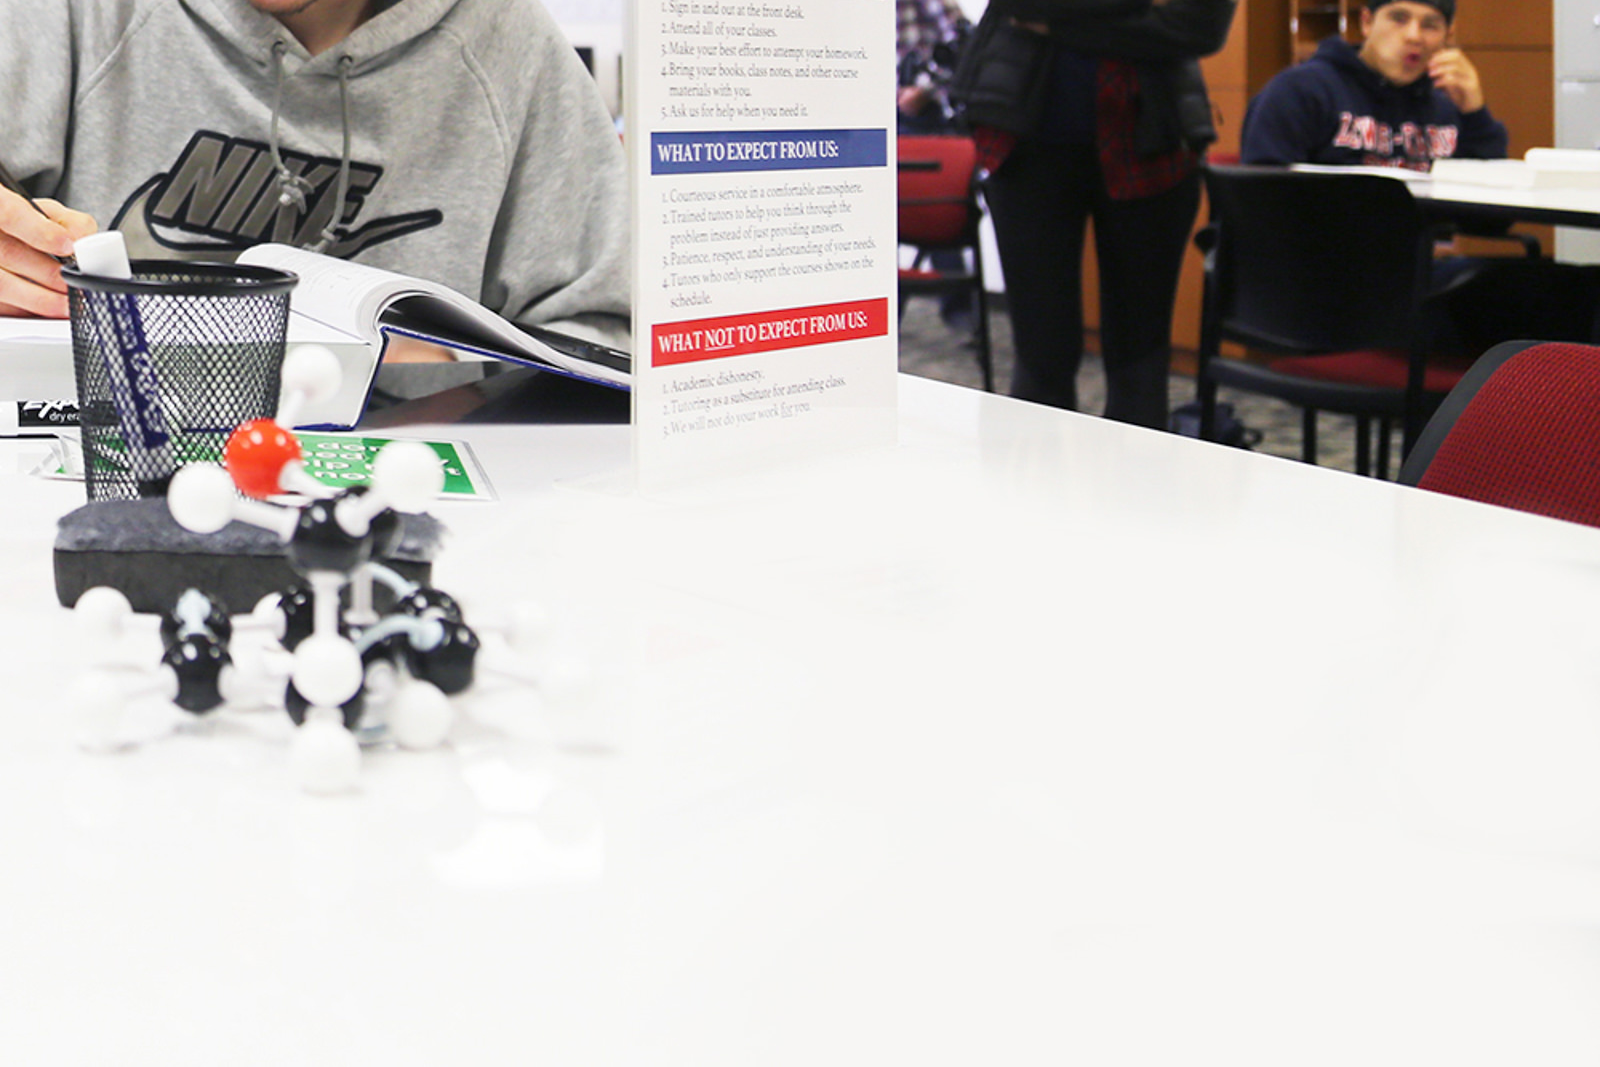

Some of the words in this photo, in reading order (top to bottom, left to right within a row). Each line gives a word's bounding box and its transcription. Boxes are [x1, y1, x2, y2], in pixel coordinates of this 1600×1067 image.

[691, 0, 700, 14] in
[702, 0, 719, 15] and
[721, 5, 735, 16] out
[746, 2, 761, 17] the
[762, 3, 783, 17] front
[670, 20, 700, 35] Attend
[702, 20, 713, 35] all
[715, 21, 725, 35] of
[726, 26, 745, 40] your
[669, 41, 695, 55] Make
[696, 45, 717, 60] your
[719, 42, 737, 56] best
[738, 42, 761, 56] effort
[763, 46, 771, 57] to
[805, 48, 823, 62] your
[670, 61, 694, 80] Bring
[696, 66, 717, 80] your
[747, 62, 767, 77] class
[795, 64, 810, 78] and
[811, 64, 832, 78] other
[833, 68, 859, 79] course
[669, 82, 711, 96] materials
[712, 82, 733, 96] with
[671, 102, 687, 117] Ask
[688, 107, 699, 118] us
[701, 102, 714, 117] for
[715, 102, 735, 122] help
[736, 103, 760, 117] when
[761, 107, 778, 121] you
[779, 102, 799, 117] need
[657, 143, 703, 162] WHAT
[704, 142, 725, 161] TO
[726, 141, 779, 161] EXPECT
[780, 140, 817, 159] FROM
[819, 140, 840, 158] US:
[149, 130, 384, 251] NIKE
[670, 188, 716, 203] Courteous
[718, 186, 748, 200] service
[749, 184, 758, 199] in
[766, 182, 815, 198] comfortable
[670, 207, 706, 224] Trained
[708, 209, 733, 221] tutors
[735, 209, 744, 220] to
[745, 204, 765, 223] help
[766, 207, 781, 221] you
[783, 201, 804, 216] think
[806, 200, 837, 218] through
[839, 199, 852, 213] the
[670, 229, 708, 249] problem
[710, 225, 741, 242] instead
[742, 224, 753, 239] of
[753, 228, 768, 242] just
[770, 222, 809, 241] providing
[747, 244, 763, 259] and
[765, 241, 822, 257] understanding
[824, 238, 834, 253] of
[834, 241, 851, 255] your
[670, 272, 701, 287] Tutors
[702, 268, 721, 283] who
[723, 266, 741, 284] only
[743, 267, 776, 284] support
[778, 262, 791, 276] the
[792, 264, 822, 276] courses
[824, 258, 849, 272] shown
[850, 260, 860, 270] on
[861, 254, 874, 269] the
[658, 330, 703, 353] WHAT
[704, 326, 735, 350] NOT
[737, 324, 756, 344] TO
[758, 318, 808, 341] EXPECT
[809, 314, 846, 334] FROM
[847, 310, 868, 329] US:
[670, 373, 715, 393] Academic
[670, 395, 711, 414] Tutoring
[712, 396, 723, 407] as
[730, 388, 772, 405] substitute
[773, 382, 786, 397] for
[786, 377, 825, 395] attending
[49, 412, 66, 423] dry
[670, 420, 686, 434] We
[707, 416, 723, 430] not
[723, 411, 735, 426] do
[735, 411, 756, 428] your
[758, 403, 779, 419] work
[780, 401, 793, 418] for
